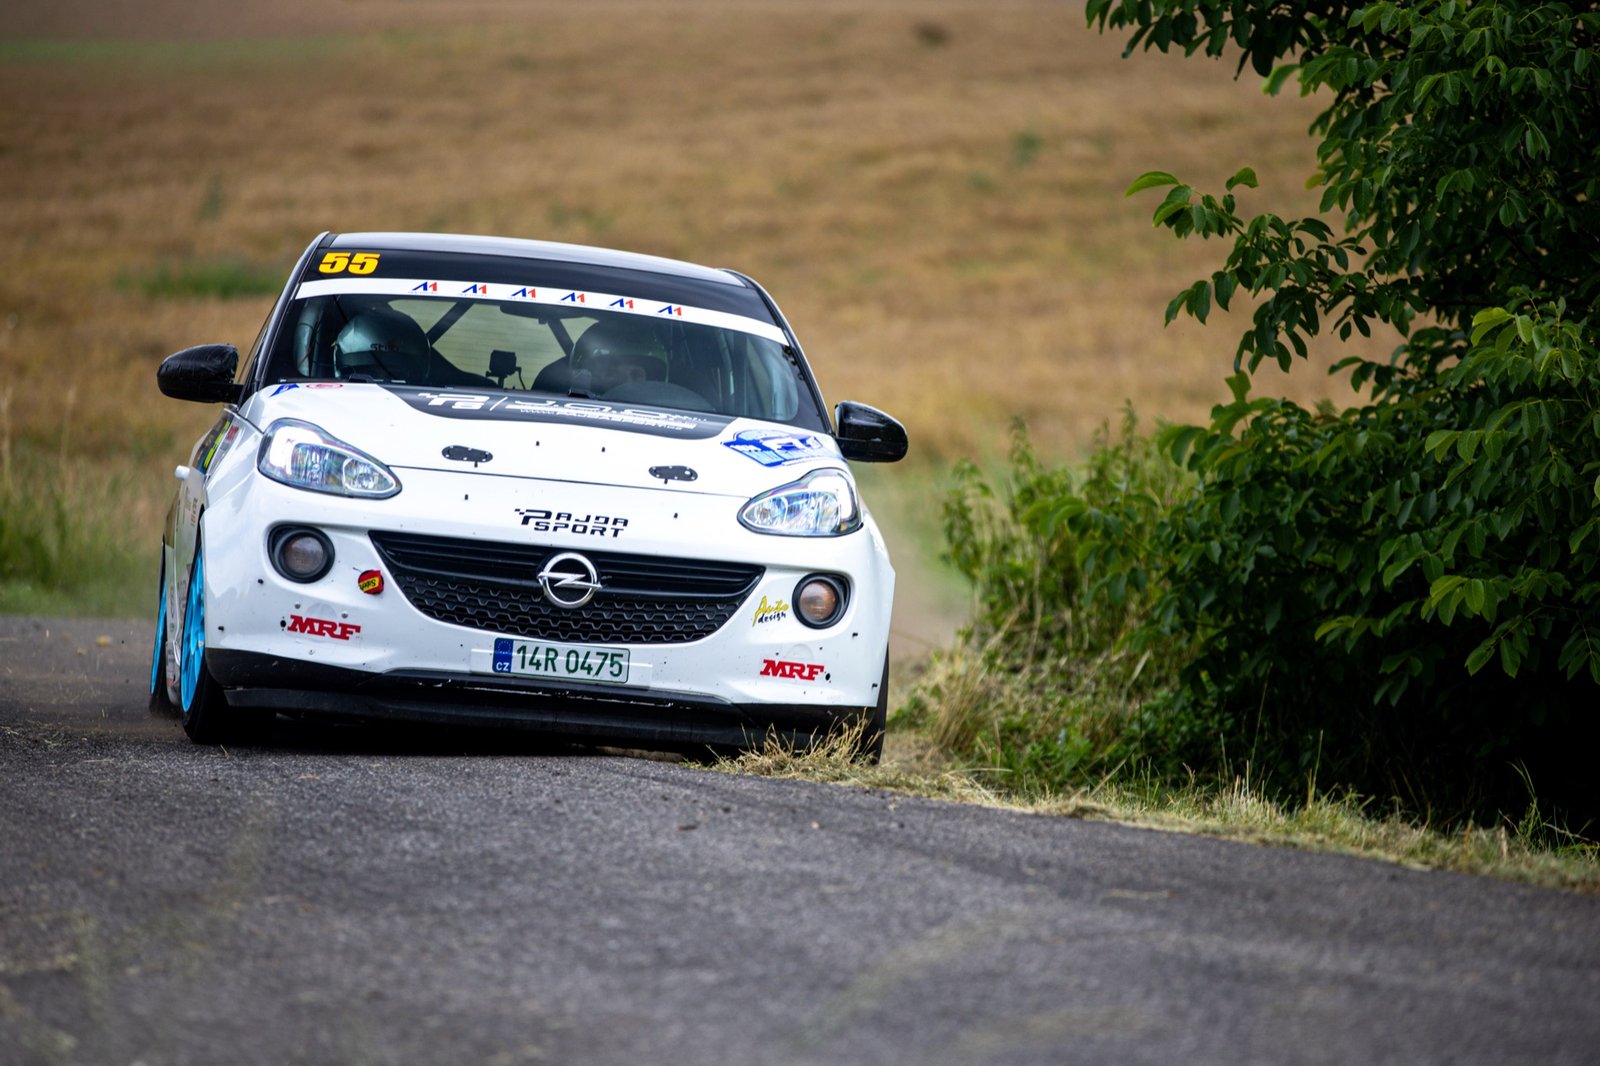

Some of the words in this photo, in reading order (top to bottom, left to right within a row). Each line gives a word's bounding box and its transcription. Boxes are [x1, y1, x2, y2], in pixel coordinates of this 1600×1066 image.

[318, 252, 381, 275] 55
[534, 521, 625, 538] SPORT
[287, 614, 362, 641] MRF
[757, 611, 787, 624] design
[496, 662, 510, 672] CZ
[516, 645, 559, 673] 14R
[565, 649, 624, 677] 0475
[760, 659, 825, 681] MRF
